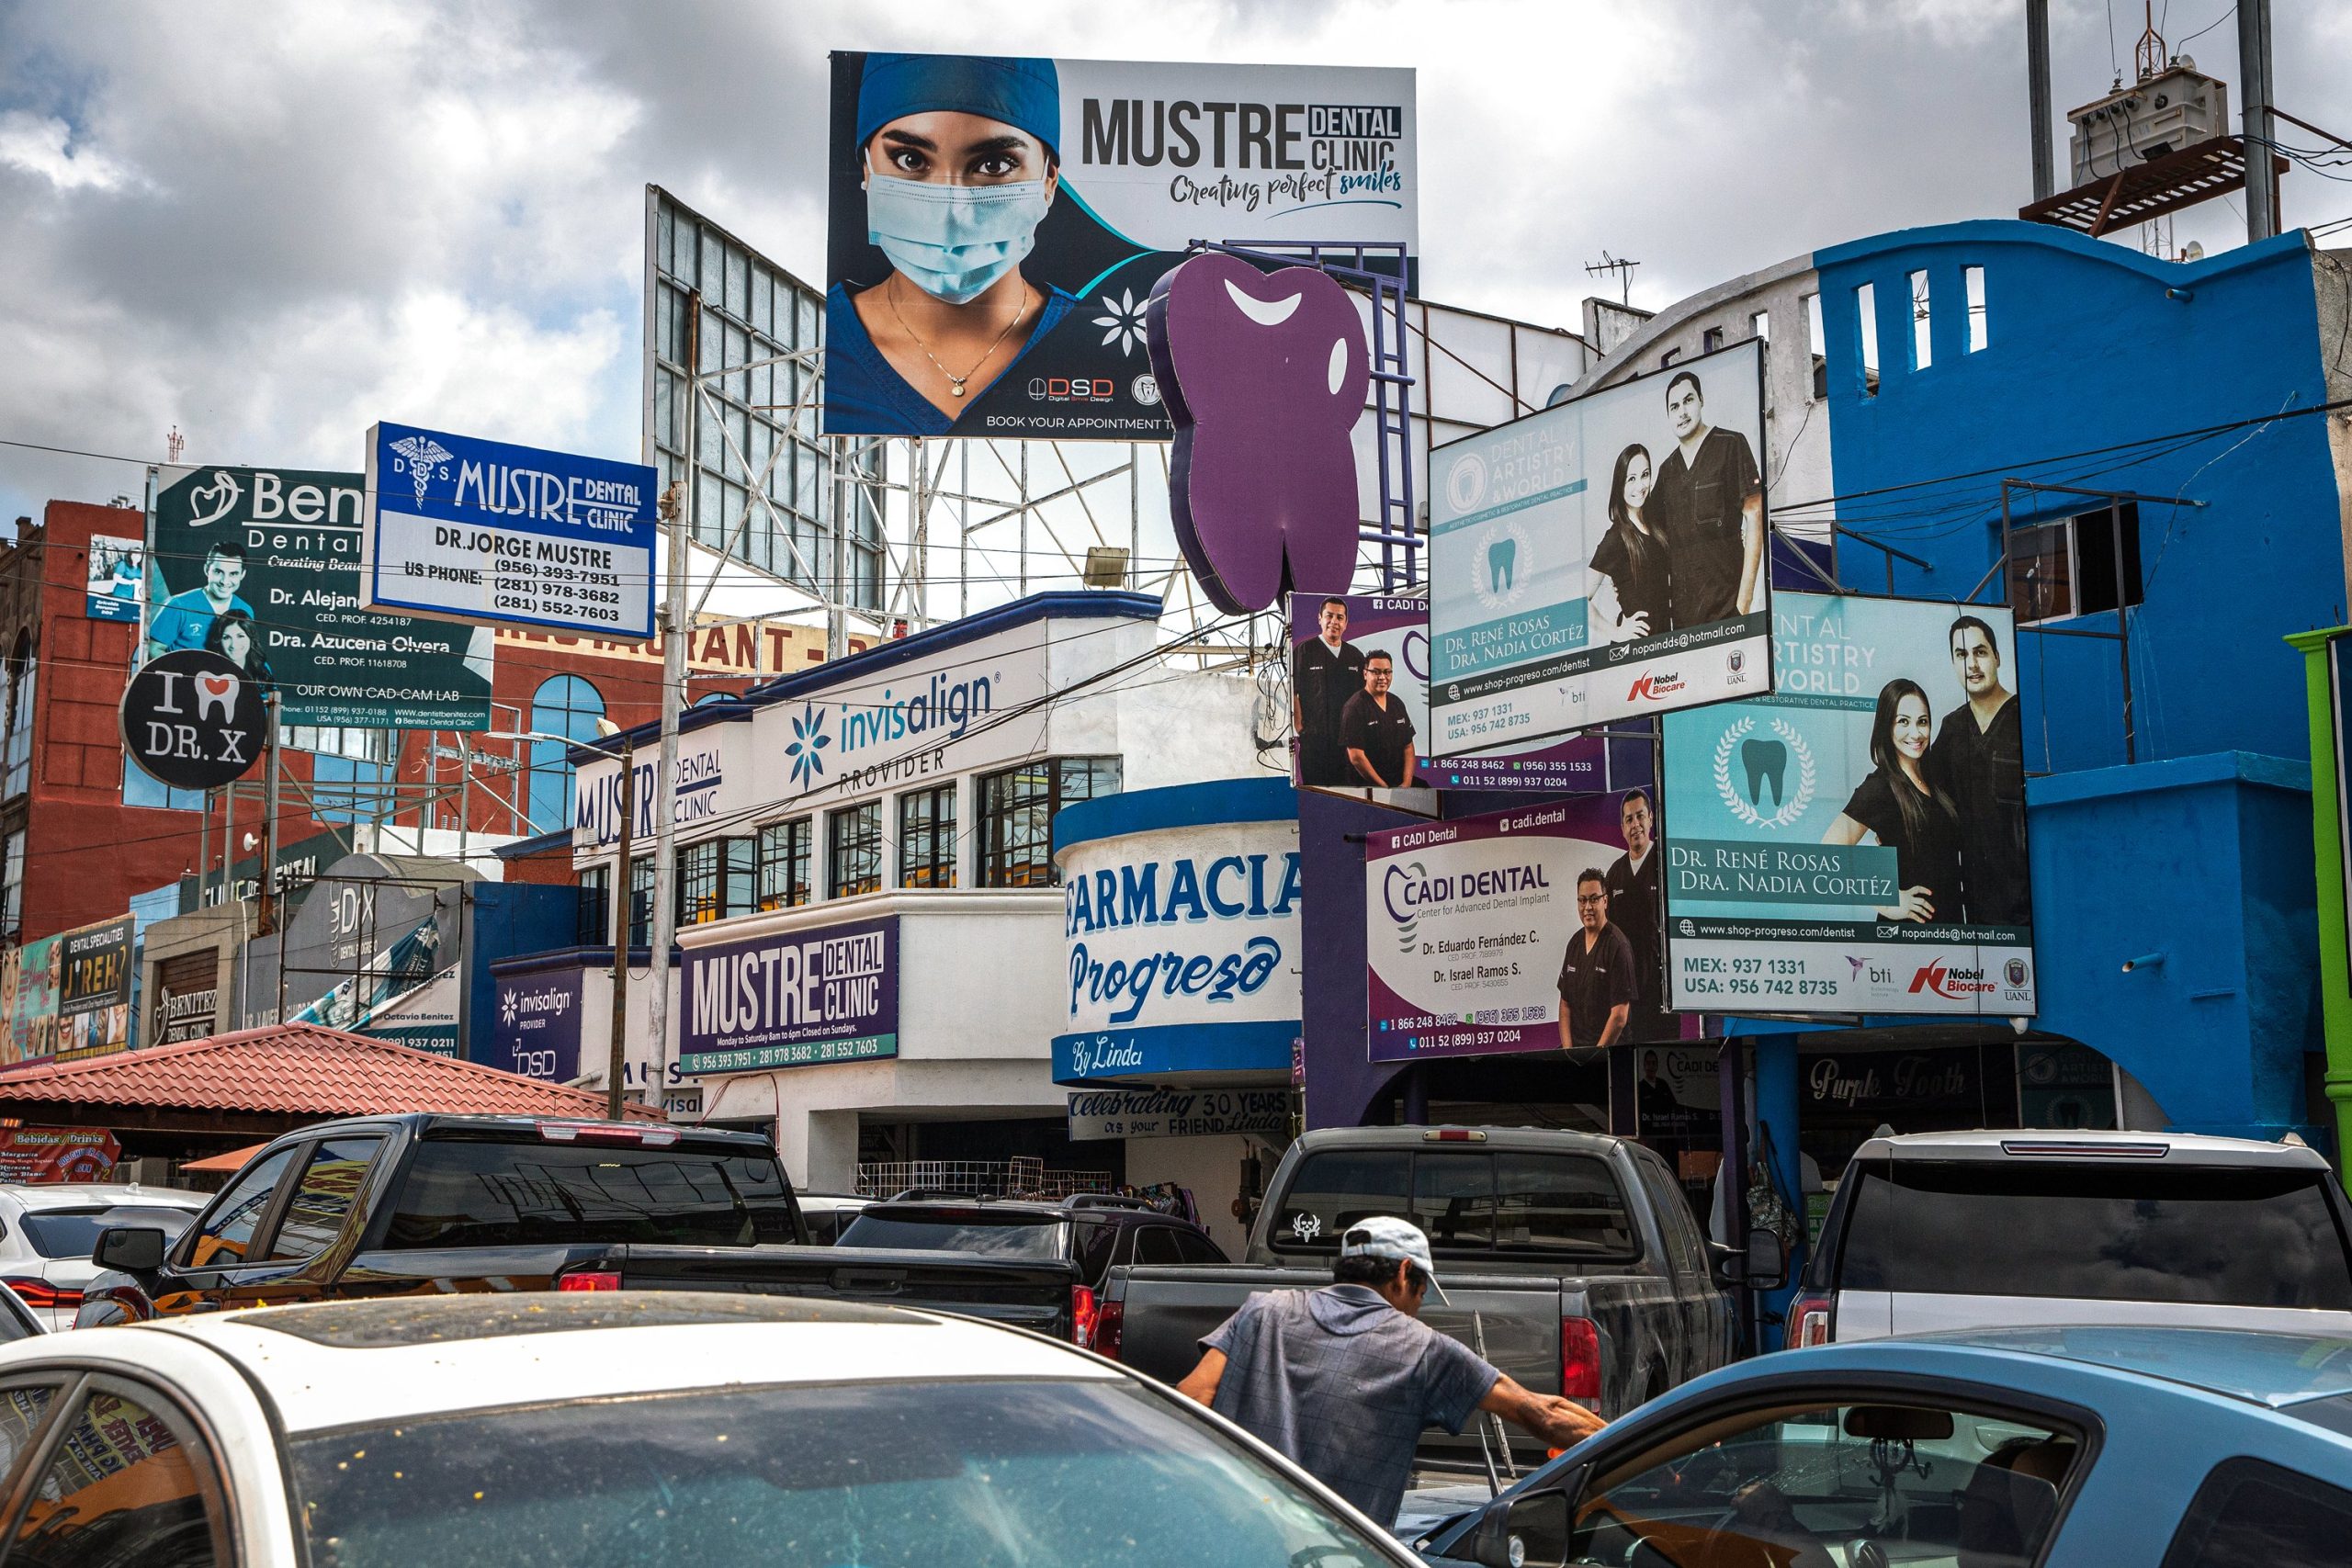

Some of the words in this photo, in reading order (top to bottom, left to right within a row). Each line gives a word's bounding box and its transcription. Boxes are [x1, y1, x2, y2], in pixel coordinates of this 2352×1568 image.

[1082, 98, 1306, 170] MUSTRE
[1312, 107, 1399, 137] DENTAL
[1312, 140, 1395, 172] CLINIC
[1170, 175, 1261, 212] Creating
[1268, 167, 1337, 205] perfect
[1340, 161, 1401, 195] smiles
[1048, 378, 1114, 396] DSD
[987, 415, 1025, 427] BOOK
[1028, 417, 1064, 428] YOUR
[1068, 418, 1161, 430] APPOINTMENT
[1491, 426, 1559, 462] DENTAL
[1493, 441, 1575, 483] ARTISTRY
[253, 472, 364, 525] Ben
[455, 459, 582, 525] MUSTRE
[585, 479, 641, 506] DENTAL
[587, 508, 633, 534] CLINIC
[248, 529, 361, 553] Dental
[537, 541, 612, 570] MUSTRE
[405, 561, 424, 577] US
[429, 565, 482, 586] PHONE:
[494, 558, 538, 578] (956)
[543, 565, 620, 588] 393-7951
[270, 588, 295, 605] Dr.
[494, 577, 538, 596] (281)
[542, 583, 619, 604] 978-3682
[494, 595, 538, 614] (281)
[542, 602, 619, 622] 552-7603
[1387, 599, 1414, 610] CADI
[316, 613, 338, 623] CED.
[369, 616, 412, 626] 4254187
[1509, 615, 1550, 637] ROSAS
[268, 630, 306, 648] Dra.
[311, 633, 387, 651] Azucena
[391, 636, 450, 654] Olvera
[1451, 652, 1479, 670] DRA.
[1484, 640, 1527, 662] NADIA
[1531, 624, 1584, 649] CORTÉZ
[368, 659, 407, 669] 11618708
[1463, 657, 1590, 695] www.shop-progreso.com/dentist
[1632, 623, 1746, 656] nopaindds@hotmail.com
[153, 670, 183, 714] I
[297, 684, 325, 696] OUR
[328, 685, 363, 698] OWN
[366, 687, 434, 701] CAD-CAM
[436, 690, 459, 702] LAB
[1447, 714, 1471, 727] MEX:
[1473, 708, 1488, 721] 937
[1491, 703, 1512, 717] 1331
[1654, 671, 1679, 684] Nobel
[1762, 696, 1809, 705] RESTORATIVE
[1839, 700, 1874, 709] PRACTICE
[1448, 728, 1468, 740] USA:
[1471, 721, 1487, 734] 956
[1489, 717, 1506, 731] 742
[1508, 713, 1531, 727] 8735
[1653, 681, 1686, 694] Biocare
[145, 722, 209, 761] DR.
[217, 729, 247, 764] X
[840, 748, 944, 794] PROVIDER
[1441, 760, 1459, 769] 866
[1461, 760, 1479, 769] 248
[1481, 761, 1505, 770] 8462
[1522, 761, 1547, 772] (956)
[1549, 761, 1567, 771] 355
[1569, 762, 1592, 772] 1533
[1463, 775, 1481, 785] 011
[1484, 776, 1496, 785] 52
[1498, 776, 1522, 787] (899)
[1524, 777, 1542, 786] 937
[1544, 777, 1567, 787] 0204
[674, 790, 718, 822] CLINIC
[1403, 832, 1425, 847] CADI
[1429, 827, 1457, 843] Dental
[1512, 808, 1566, 829] cadi.dental
[1670, 847, 1706, 867] DR.
[1715, 848, 1769, 870] RENÉ
[1776, 851, 1840, 873] ROSAS
[1404, 876, 1453, 906] CADI
[1461, 863, 1550, 898] DENTAL
[1680, 870, 1730, 891] DRA.
[1737, 873, 1807, 894] NADIA
[1813, 874, 1893, 897] CORTÉZ
[1417, 907, 1442, 919] Center
[1454, 900, 1491, 914] Advanced
[1493, 896, 1518, 909] Dental
[1520, 893, 1550, 908] Implant
[70, 937, 90, 953] DENTAL
[1422, 942, 1435, 955] Dr.
[1438, 938, 1476, 953] Eduardo
[1478, 932, 1526, 949] Fernández
[1529, 930, 1540, 943] C.
[1700, 925, 1855, 939] www.shop-progreso.com/dentist
[1069, 935, 1282, 1023] Progreso
[1433, 970, 1446, 983] Dr.
[1449, 967, 1474, 982] Israel
[1477, 964, 1509, 979] Ramos
[1684, 957, 1727, 973] MEX:
[1732, 959, 1762, 974] 937
[1767, 959, 1805, 975] 1331
[1948, 967, 1984, 980] Nobel
[692, 941, 822, 1036] MUSTRE
[827, 934, 882, 977] DENTAL
[1685, 978, 1724, 994] USA:
[1729, 979, 1759, 995] 956
[1764, 980, 1793, 995] 742
[1798, 980, 1838, 996] 8735
[1947, 980, 1996, 993] Biocare
[169, 989, 218, 1019] BENITEZ
[520, 987, 570, 1015] invisalign
[824, 976, 879, 1021] CLINIC
[520, 1019, 546, 1031] PROVIDER
[1397, 1017, 1415, 1030] 866
[1416, 1016, 1433, 1028] 248
[1435, 1013, 1458, 1026] 8462
[408, 1038, 428, 1047] 937
[431, 1038, 455, 1047] 0211
[717, 1035, 738, 1047] Monday
[744, 1032, 768, 1045] Saturday
[802, 1027, 821, 1037] Closed
[1419, 1035, 1435, 1048] 011
[1438, 1034, 1449, 1046] 52
[1452, 1032, 1475, 1047] (899)
[1477, 1032, 1495, 1044] 937
[1497, 1030, 1521, 1043] 0204
[517, 1050, 556, 1077] DSD
[703, 1055, 717, 1068] 956
[718, 1054, 732, 1067] 393
[734, 1052, 752, 1066] 7951
[791, 1045, 811, 1061] 3682
[837, 1042, 854, 1056] 552
[856, 1038, 877, 1055] 7603
[1072, 1041, 1091, 1077] By
[1092, 1036, 1143, 1068] Linda
[1677, 1061, 1702, 1072] CADI
[1809, 1057, 1882, 1109] Purple
[1894, 1056, 1965, 1097] Tooth
[1203, 1094, 1231, 1116] 30
[1237, 1092, 1286, 1113] YEARS
[1105, 1120, 1123, 1134] as
[1131, 1120, 1159, 1134] your
[1169, 1117, 1225, 1134] FRIEND
[1227, 1111, 1282, 1132] Linda
[17, 1134, 60, 1144] Bebidas
[70, 1134, 104, 1143] Drinks
